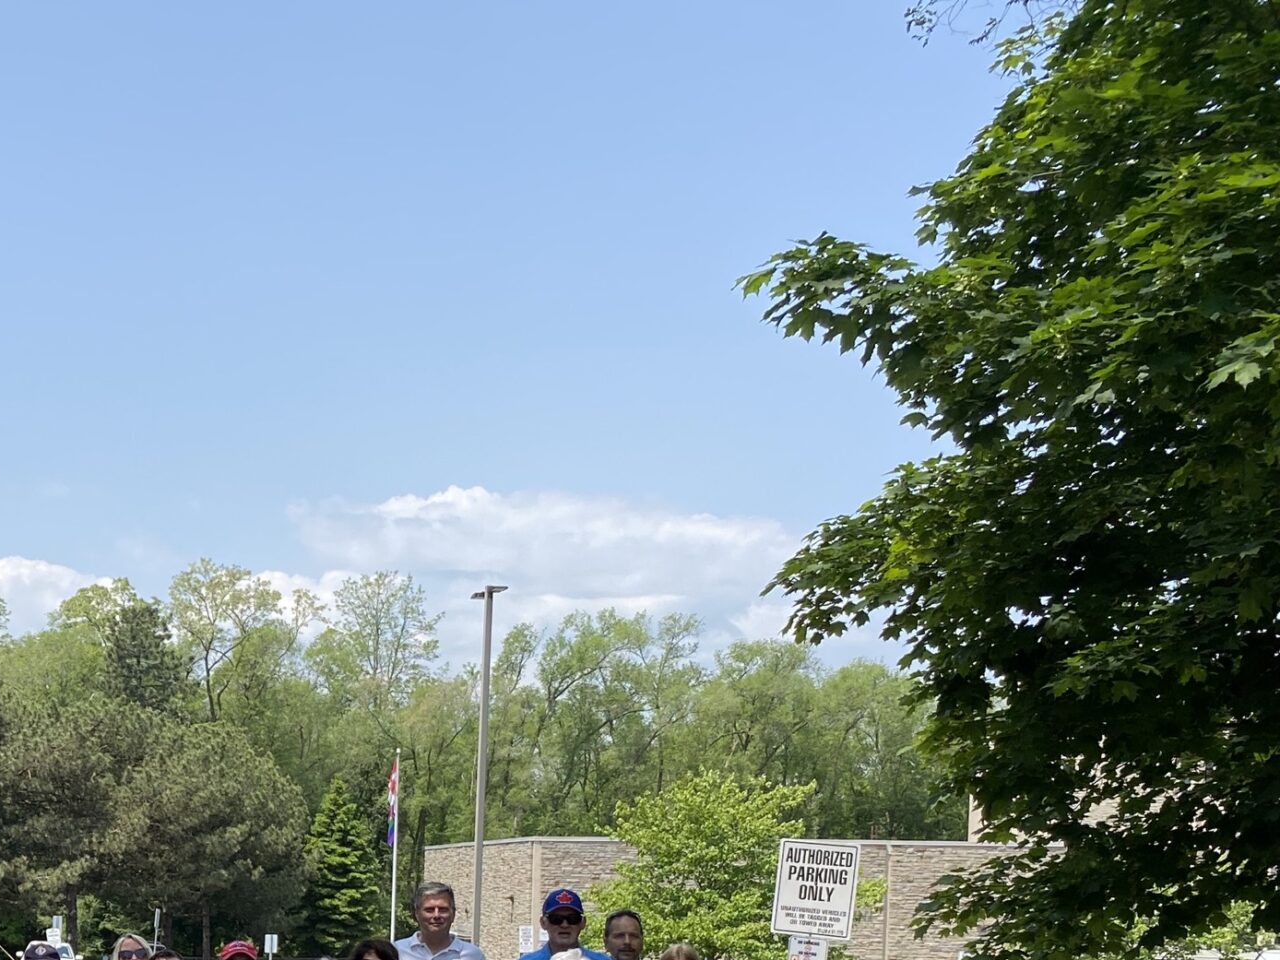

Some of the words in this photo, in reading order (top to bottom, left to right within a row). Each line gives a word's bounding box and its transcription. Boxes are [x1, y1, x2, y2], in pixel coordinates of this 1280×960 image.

[786, 847, 853, 868] AUTHORIZED
[788, 865, 848, 885] PARKING
[798, 884, 835, 902] ONLY
